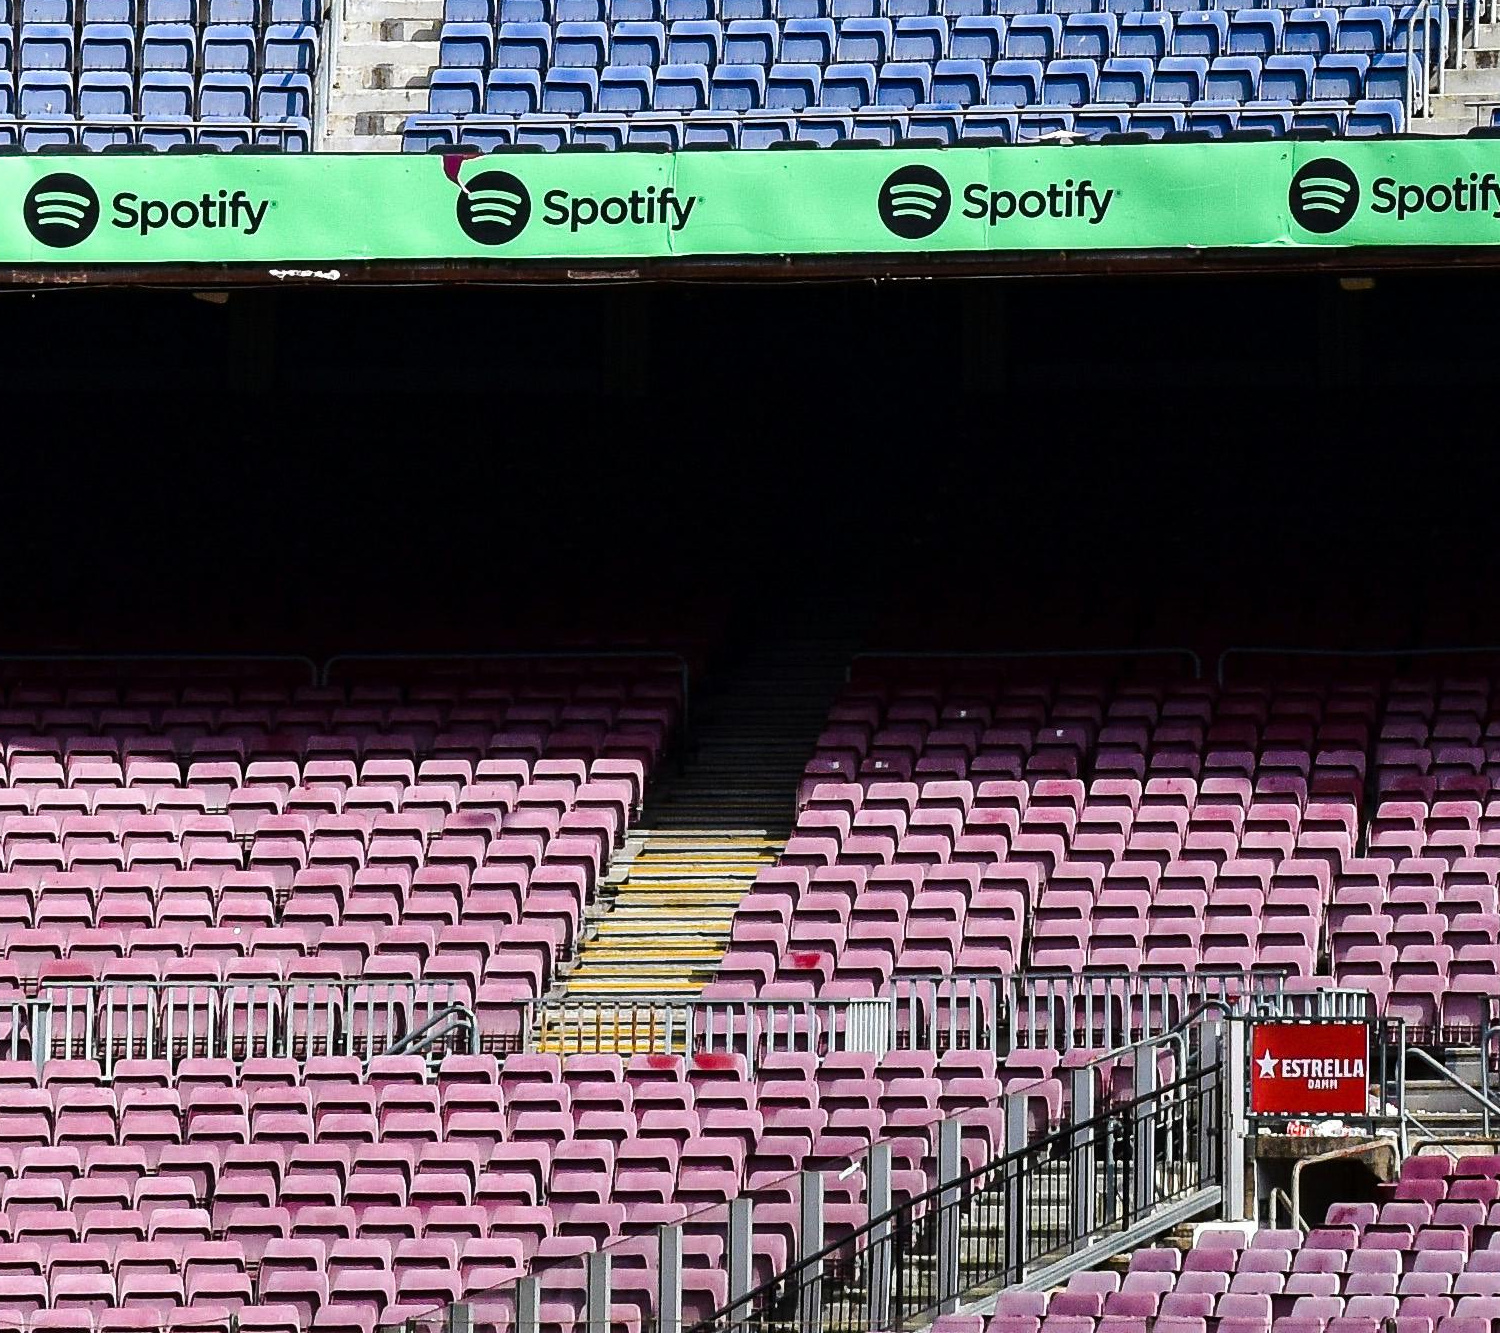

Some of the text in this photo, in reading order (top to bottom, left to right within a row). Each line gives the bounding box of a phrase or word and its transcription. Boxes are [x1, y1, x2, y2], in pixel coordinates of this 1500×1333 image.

[111, 189, 269, 236] Spotify
[542, 185, 696, 233] Spotify
[962, 179, 1114, 226] Spotify
[1282, 1058, 1365, 1078] ESTRELLA
[1307, 1078, 1338, 1090] DAMM
